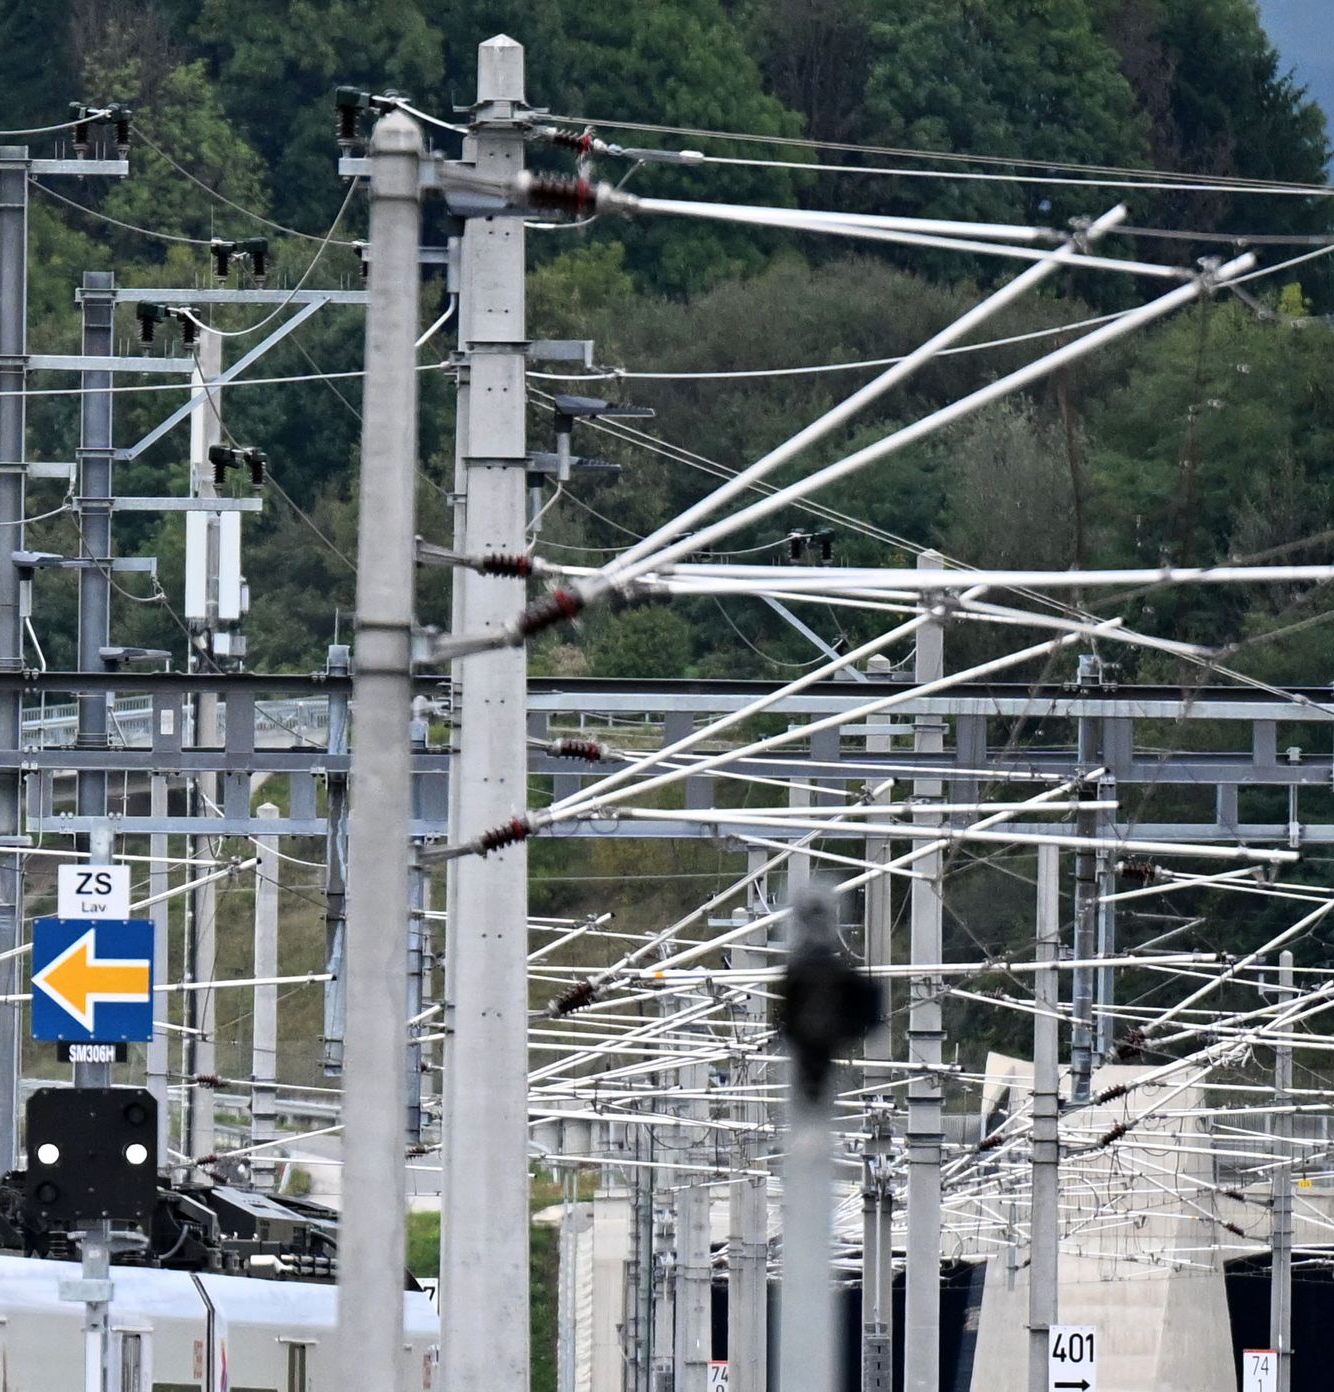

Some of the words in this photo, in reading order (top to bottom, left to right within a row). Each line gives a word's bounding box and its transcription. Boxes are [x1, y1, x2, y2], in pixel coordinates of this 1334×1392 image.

[75, 873, 112, 895] ZS
[81, 901, 107, 914] Lav
[69, 1044, 116, 1063] SM306H
[1052, 1333, 1095, 1363] 401
[712, 1366, 729, 1383] 74
[1252, 1356, 1269, 1376] 74
